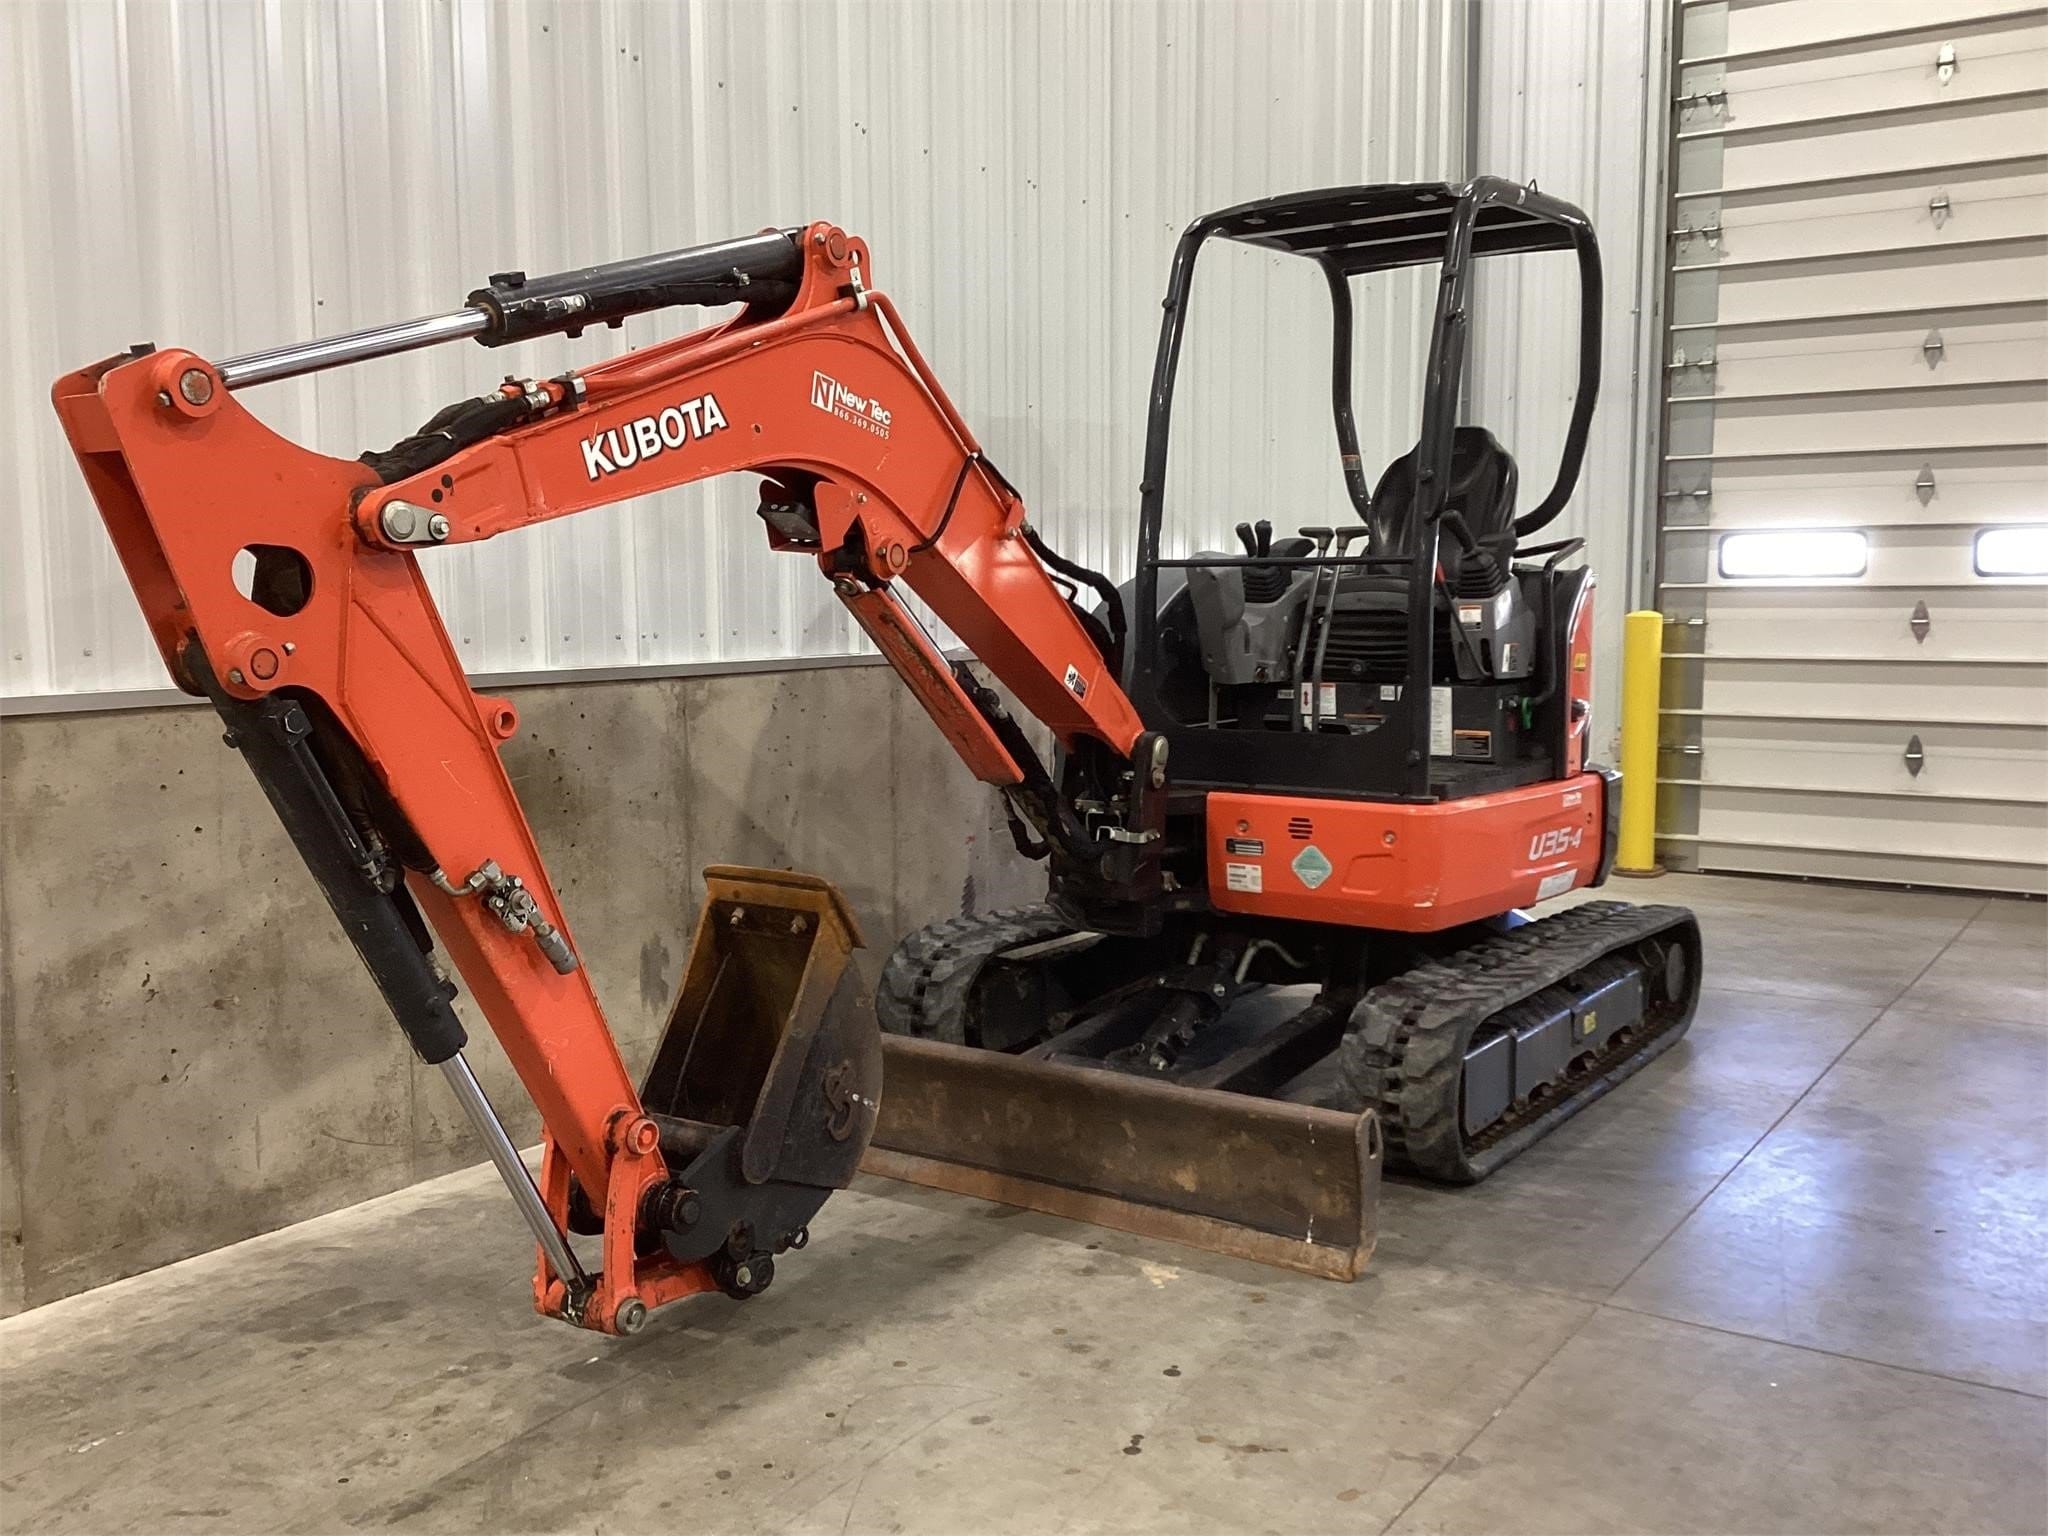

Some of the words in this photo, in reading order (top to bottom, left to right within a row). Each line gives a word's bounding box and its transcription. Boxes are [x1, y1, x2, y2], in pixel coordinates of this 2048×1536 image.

[835, 382, 868, 413] New
[869, 398, 892, 425] Tec
[580, 393, 728, 480] KUBOTA
[1528, 826, 1583, 861] U35-4
